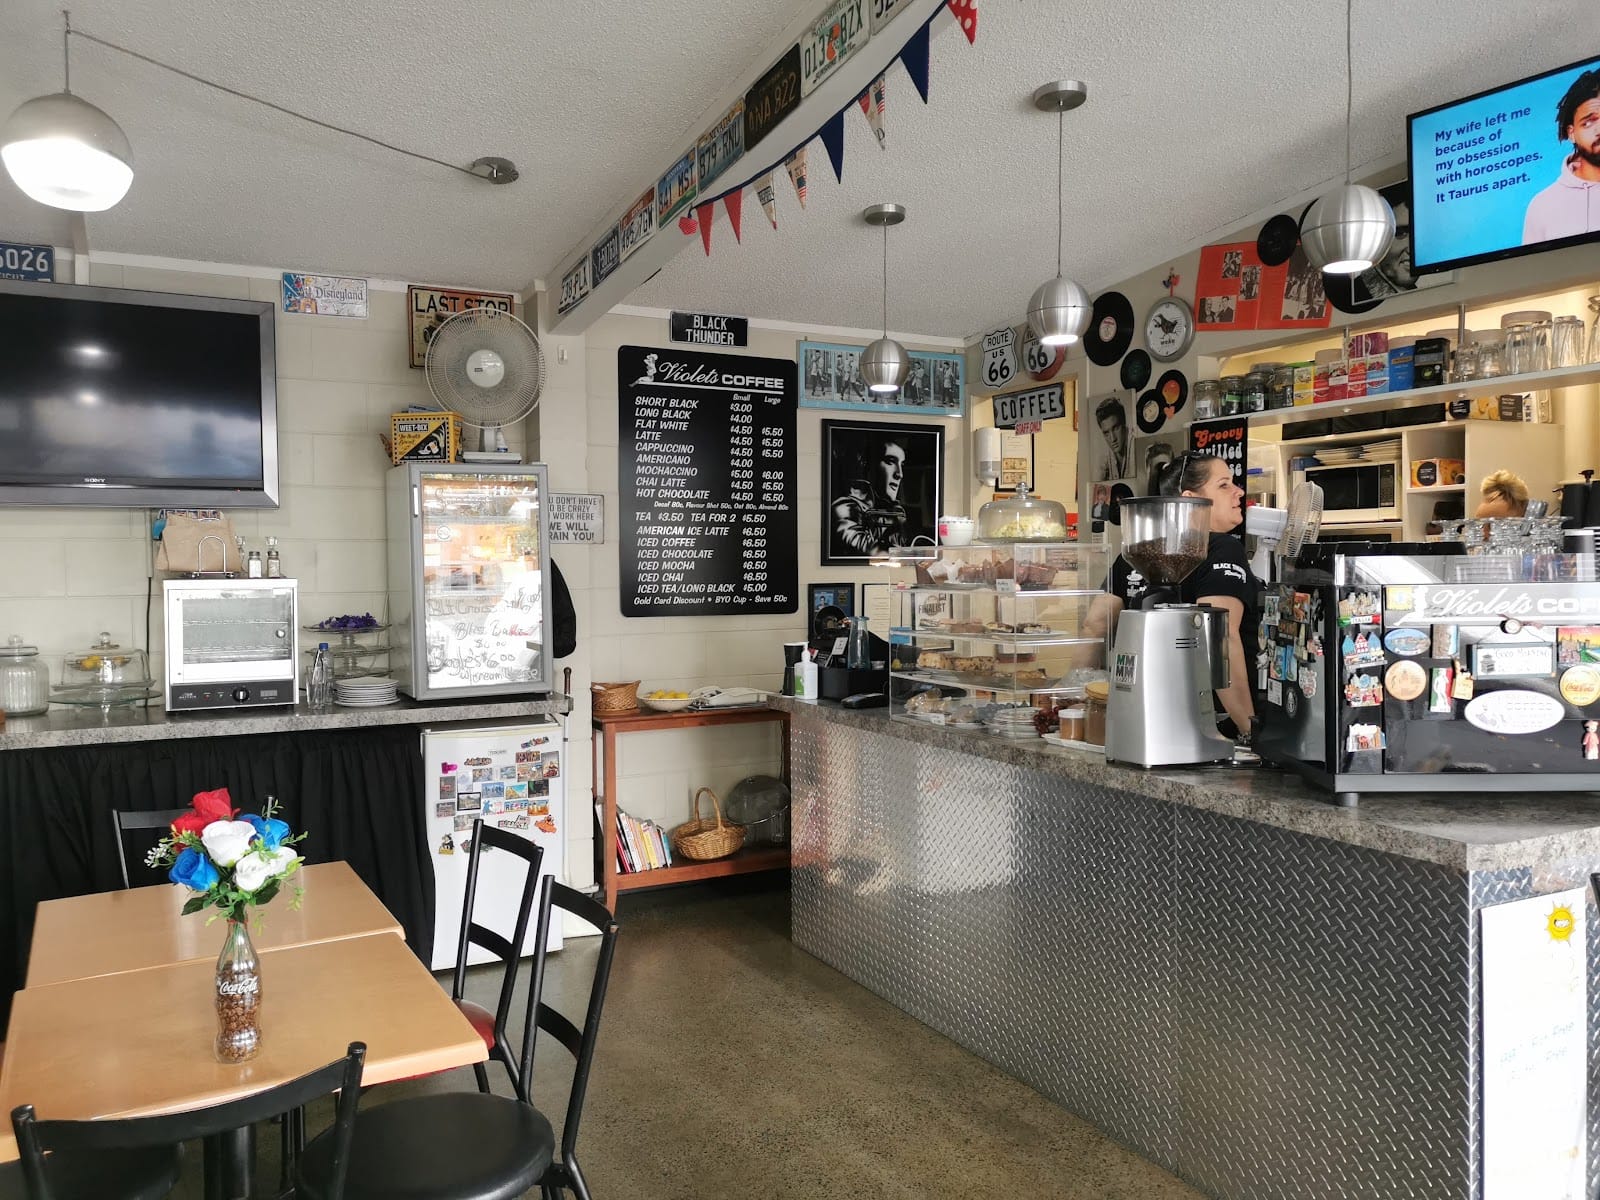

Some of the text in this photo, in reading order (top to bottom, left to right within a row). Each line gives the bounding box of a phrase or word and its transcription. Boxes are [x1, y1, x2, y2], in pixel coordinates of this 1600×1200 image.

[1435, 107, 1531, 142] My wife left me
[1436, 129, 1502, 156] because of
[1436, 141, 1520, 171] my obsession
[1436, 152, 1543, 185] with horoscopes.
[1436, 172, 1530, 203] It Taurus apart.
[316, 287, 363, 301] Disneyland
[415, 293, 508, 316] LAST STOP
[693, 315, 727, 330] BLACK
[686, 329, 734, 345] THUNDER
[987, 332, 1009, 347] ROUTE
[992, 349, 1005, 358] US
[1028, 345, 1048, 370] 66
[659, 362, 784, 389] Violets COFFEE
[989, 358, 1010, 382] 66
[635, 396, 752, 412] SHORT BLACK $3.00
[733, 394, 781, 405] Small Large
[1001, 391, 1057, 420] COFFEE
[635, 408, 752, 423] LONG BLACK $4.00
[635, 420, 783, 436] FLAT WHITE $4.50 $5.50
[635, 431, 783, 447] LATTE $4.50 $5.50
[1195, 427, 1243, 447] Groovy
[635, 442, 783, 458] CAPPUCCINO $4.50 $5.50
[636, 454, 753, 467] AMERICANO $4.00
[636, 465, 783, 479] MOCHACCINO $5.00 $6.00
[636, 477, 784, 491] CHAI LATTE $4.50 $5.50
[579, 497, 597, 505] HAVE
[636, 489, 784, 502] HOT CHOCOLATE $4.50 $5.50
[553, 512, 574, 520] WORK
[635, 512, 766, 523] TEA $3.50 TEA FOR 2 $5.50
[566, 522, 589, 531] WILL
[636, 526, 766, 536] AMERICAN ICE LATTE $6.50
[549, 532, 594, 541] RAIN YOU!
[637, 538, 766, 547] ICED COFFEE $6.50
[637, 550, 766, 559] ICED CHOCOLATE $6.50
[637, 561, 767, 570] ICED MOCHA $6.50
[638, 572, 767, 582] ICED CHAI $6.50
[638, 583, 767, 593] ICED TEA/LONG BLACK $5.00
[654, 596, 671, 604] Card
[673, 596, 705, 604] Discount
[715, 596, 731, 604] BYO
[733, 596, 746, 604] Cup
[1432, 587, 1533, 615] Violets
[919, 602, 945, 614] FINALIST
